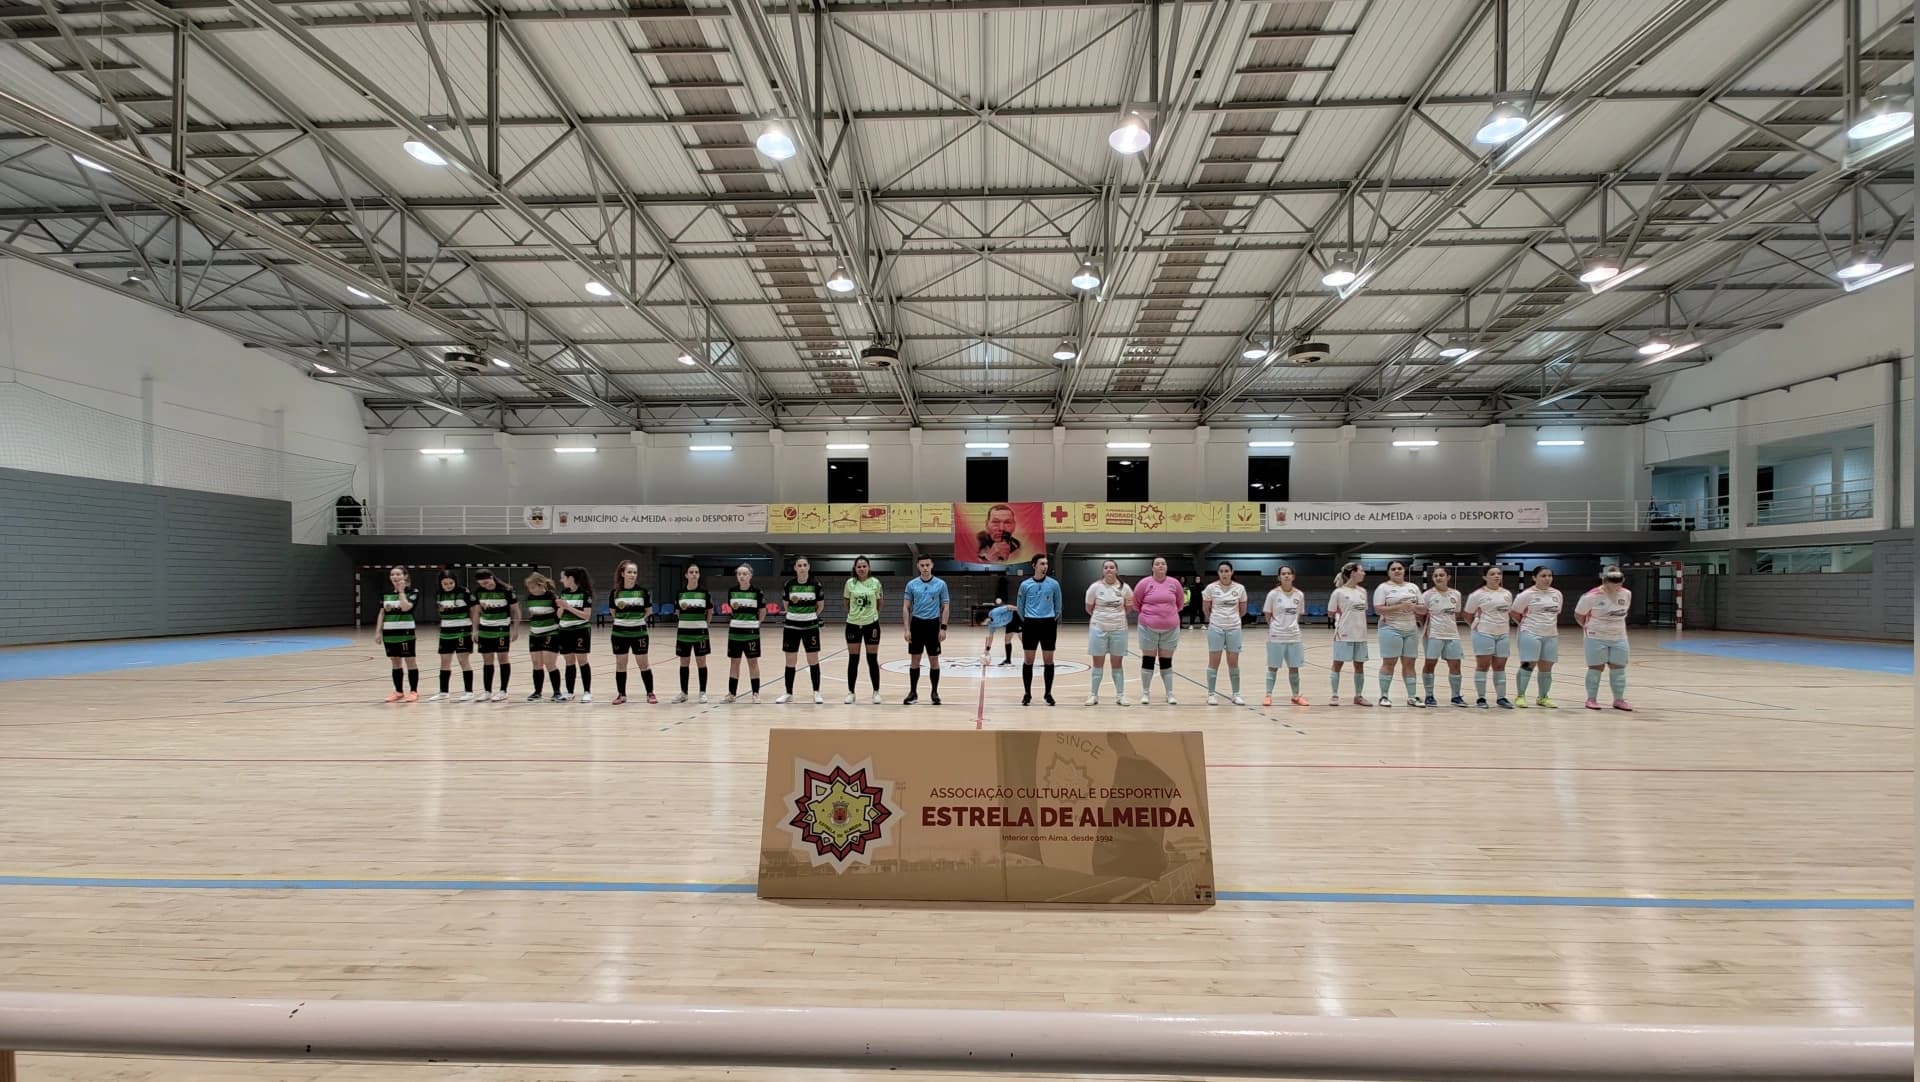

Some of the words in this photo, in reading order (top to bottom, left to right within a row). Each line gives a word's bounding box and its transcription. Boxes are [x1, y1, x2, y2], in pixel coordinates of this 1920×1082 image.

[573, 512, 618, 522] MUNICÍPIO
[631, 514, 667, 522] ALMEIDA
[702, 514, 745, 522] DESPORTO
[1293, 510, 1351, 521] MUNICÍPIO
[1353, 511, 1365, 520] de
[1368, 511, 1414, 520] ALMEIDA
[1422, 511, 1447, 522] apoia
[1459, 510, 1514, 520] DESPORTO
[1055, 732, 1104, 760] SINCE
[930, 785, 1013, 801] ASSOCIAÇÃO
[1016, 787, 1085, 799] CULTURAL
[1088, 788, 1096, 799] E
[1100, 787, 1182, 799] DESPORTIVA
[922, 806, 1034, 827] ESTRELA
[1040, 807, 1073, 827] DE
[1079, 807, 1195, 828] ALMEIDA
[1002, 833, 1028, 841] Interior
[1070, 833, 1095, 842] desde
[1096, 834, 1113, 842] 1992
